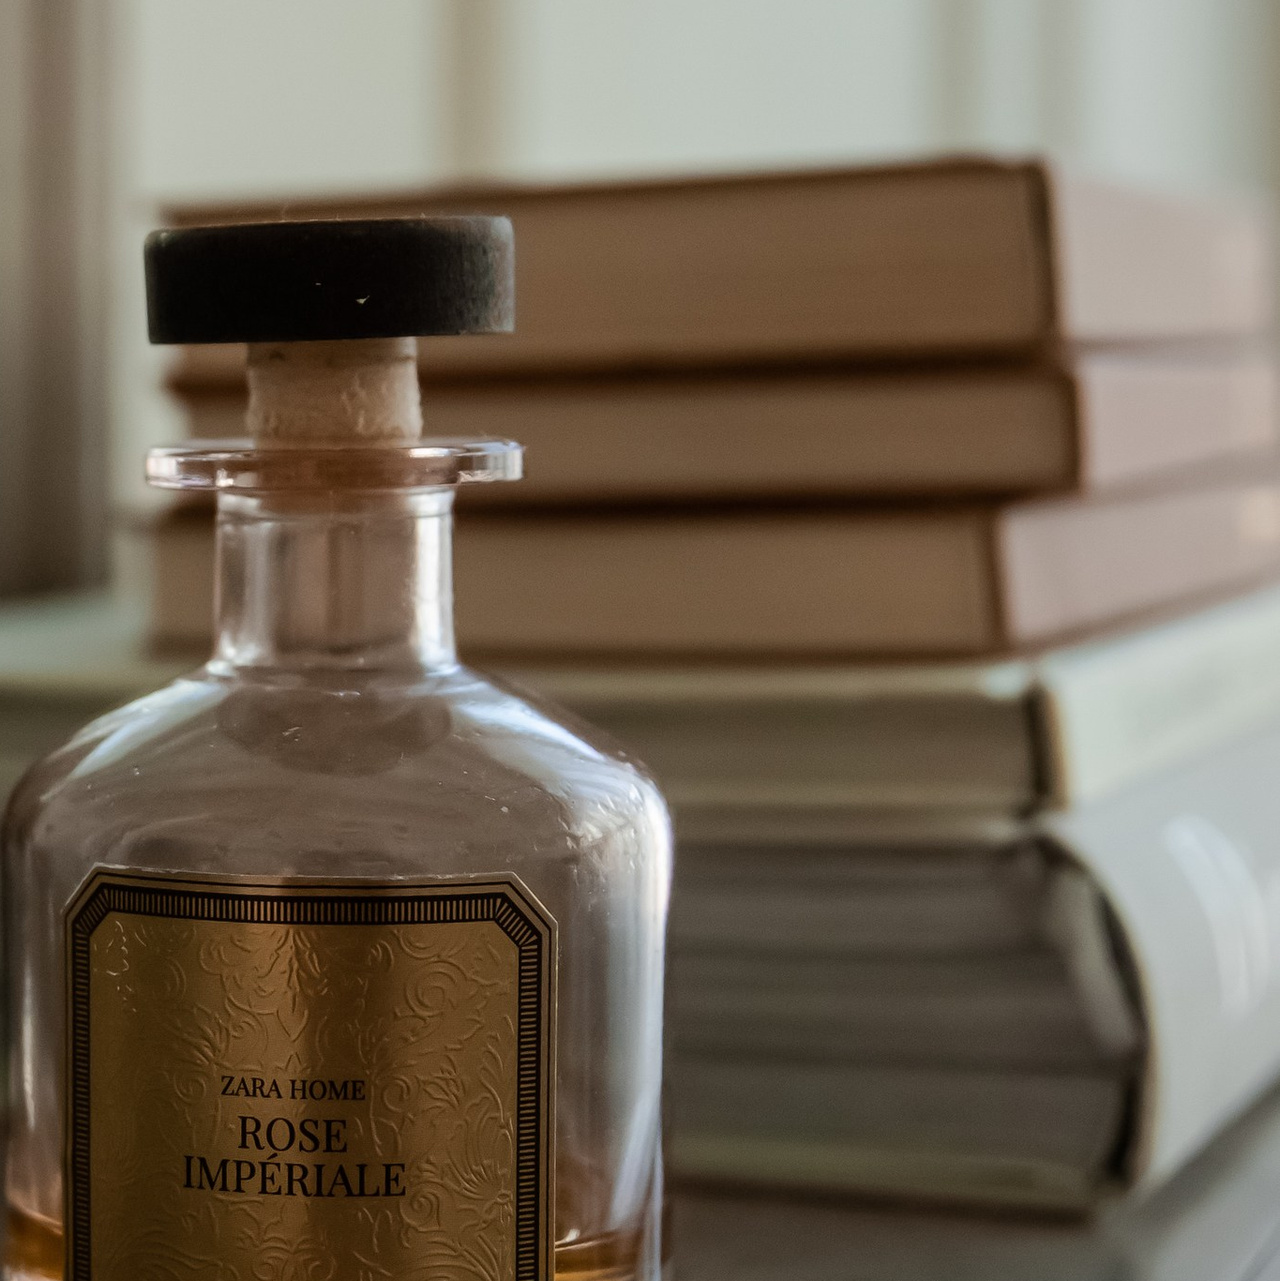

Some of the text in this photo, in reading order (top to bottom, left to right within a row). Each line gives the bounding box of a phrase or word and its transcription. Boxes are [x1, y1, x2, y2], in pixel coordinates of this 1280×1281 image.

[221, 1075, 366, 1101] ZARA HOME
[237, 1115, 348, 1153] ROSE
[183, 1153, 407, 1198] IMPÉRIALE
